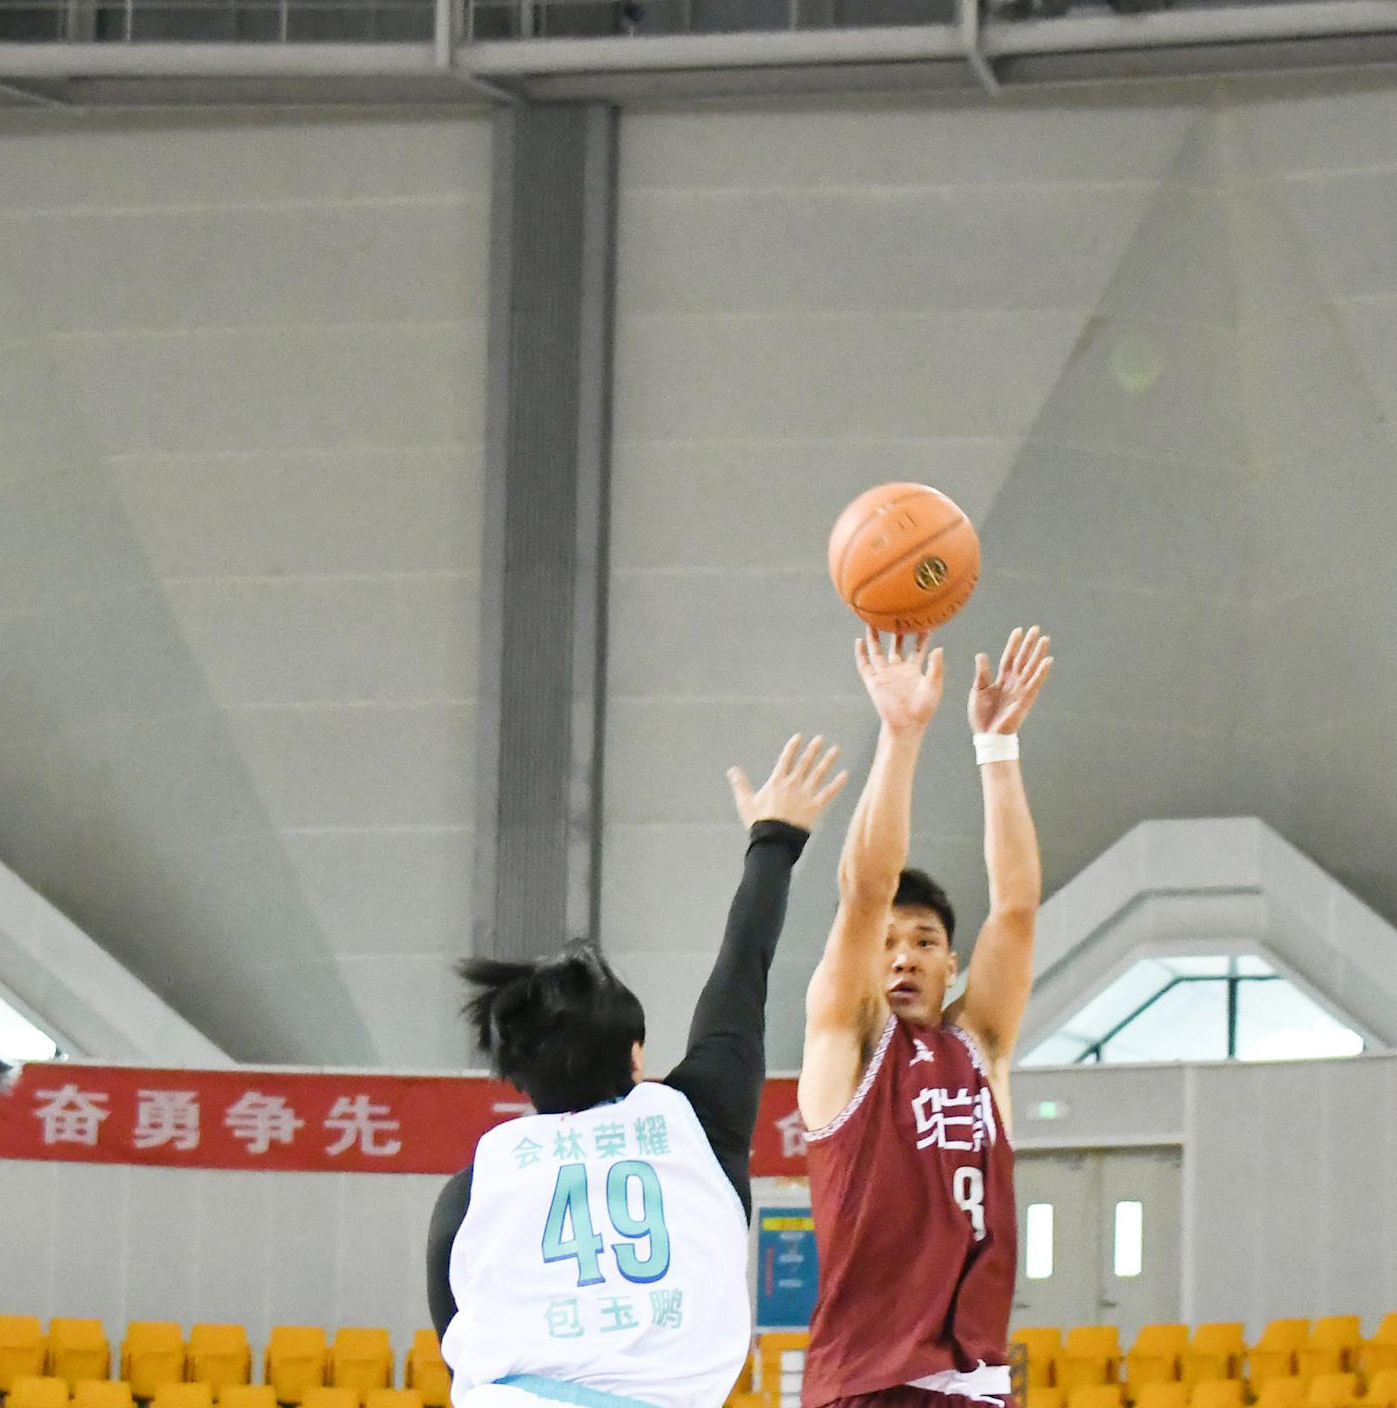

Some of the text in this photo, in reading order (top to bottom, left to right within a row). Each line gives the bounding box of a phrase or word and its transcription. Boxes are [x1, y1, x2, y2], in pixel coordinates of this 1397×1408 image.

[32, 1083, 402, 1158] 奋勇争先
[541, 1160, 672, 1287] 49
[544, 1288, 684, 1339] 包玉鹏
